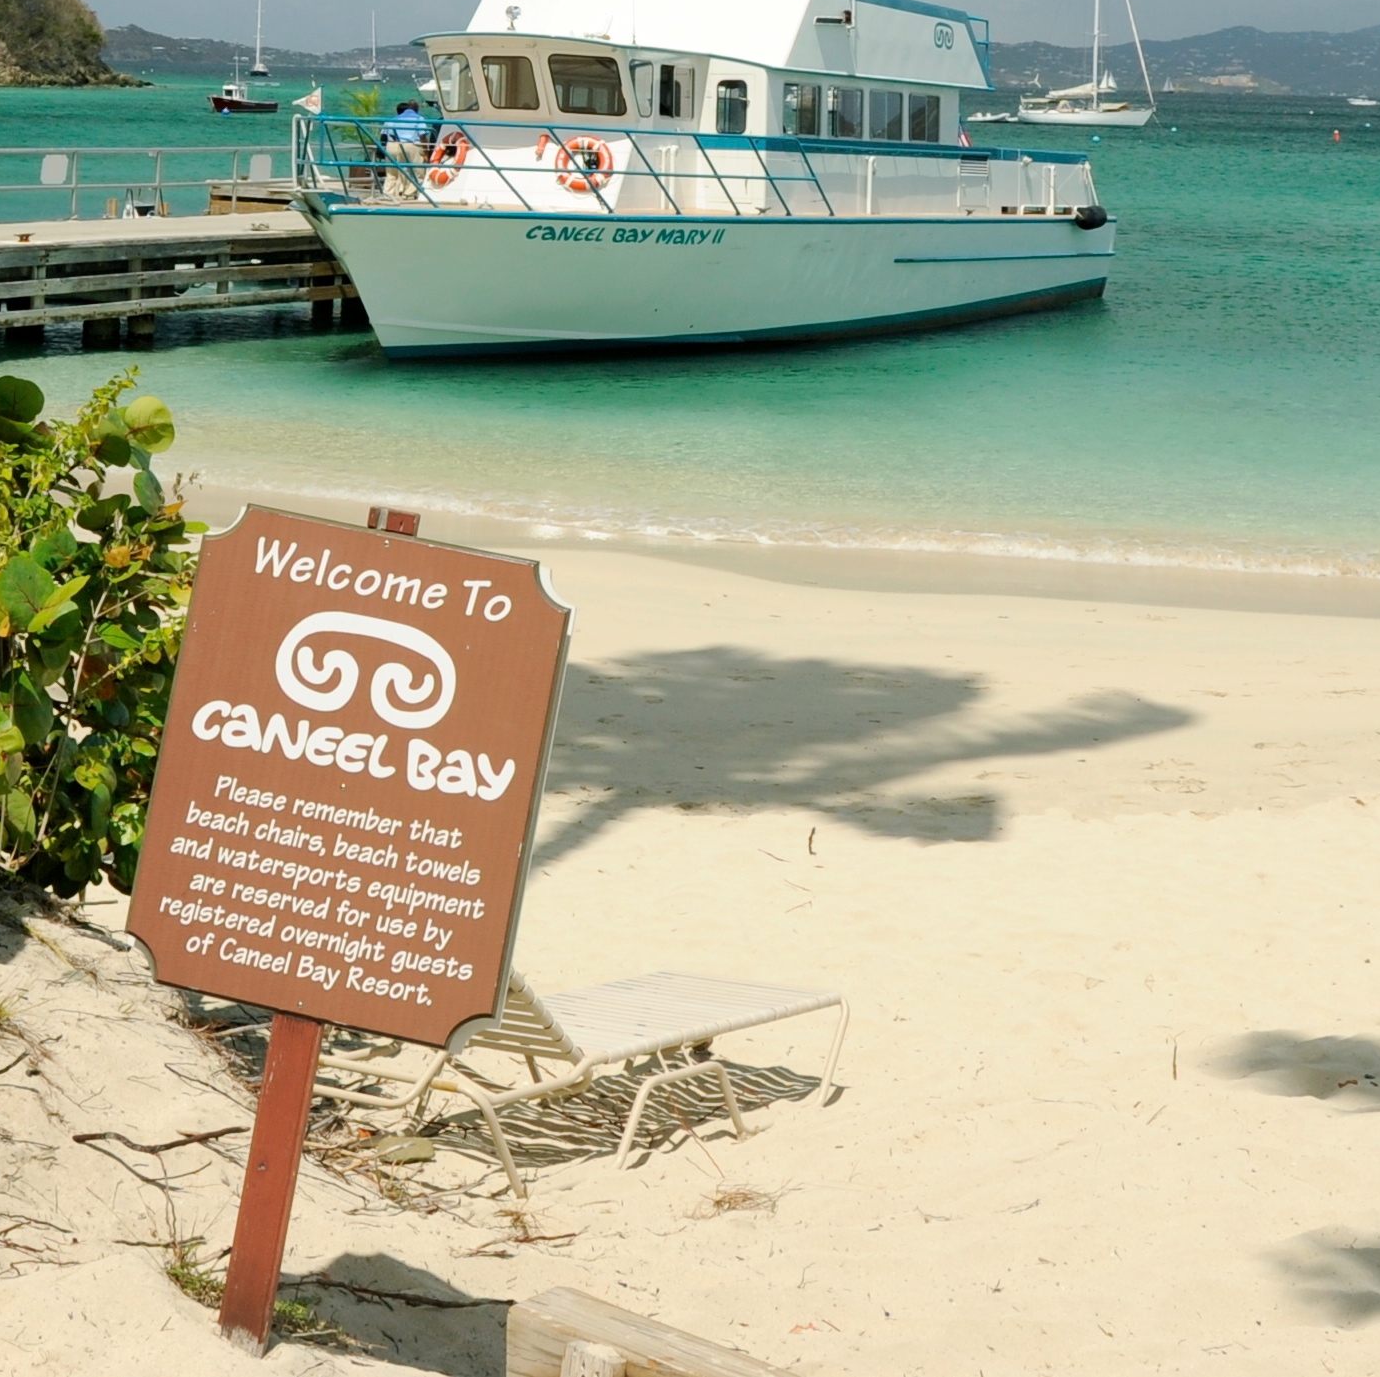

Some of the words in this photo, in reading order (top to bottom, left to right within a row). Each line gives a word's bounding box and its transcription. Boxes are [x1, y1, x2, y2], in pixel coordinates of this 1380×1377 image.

[255, 536, 448, 609] Welcome
[462, 579, 512, 622] To
[185, 800, 250, 837] beach
[254, 818, 326, 857] chairs,
[332, 833, 399, 869] beach
[405, 851, 481, 886] towels
[214, 775, 288, 812] Please
[292, 798, 403, 836] remember
[409, 819, 463, 849] that
[170, 836, 214, 861] and
[217, 846, 362, 893] watersports
[367, 881, 485, 920] equipment
[189, 874, 227, 896] are
[231, 882, 331, 920] reserved
[336, 899, 371, 928] for
[375, 914, 418, 939] use
[422, 918, 453, 951] by
[159, 896, 277, 938] registered
[280, 925, 386, 963] overnight
[390, 950, 473, 981] guests
[185, 932, 216, 956] of
[219, 937, 293, 975] Caneel
[296, 955, 341, 991] Bay
[345, 965, 433, 1007] Resort.
